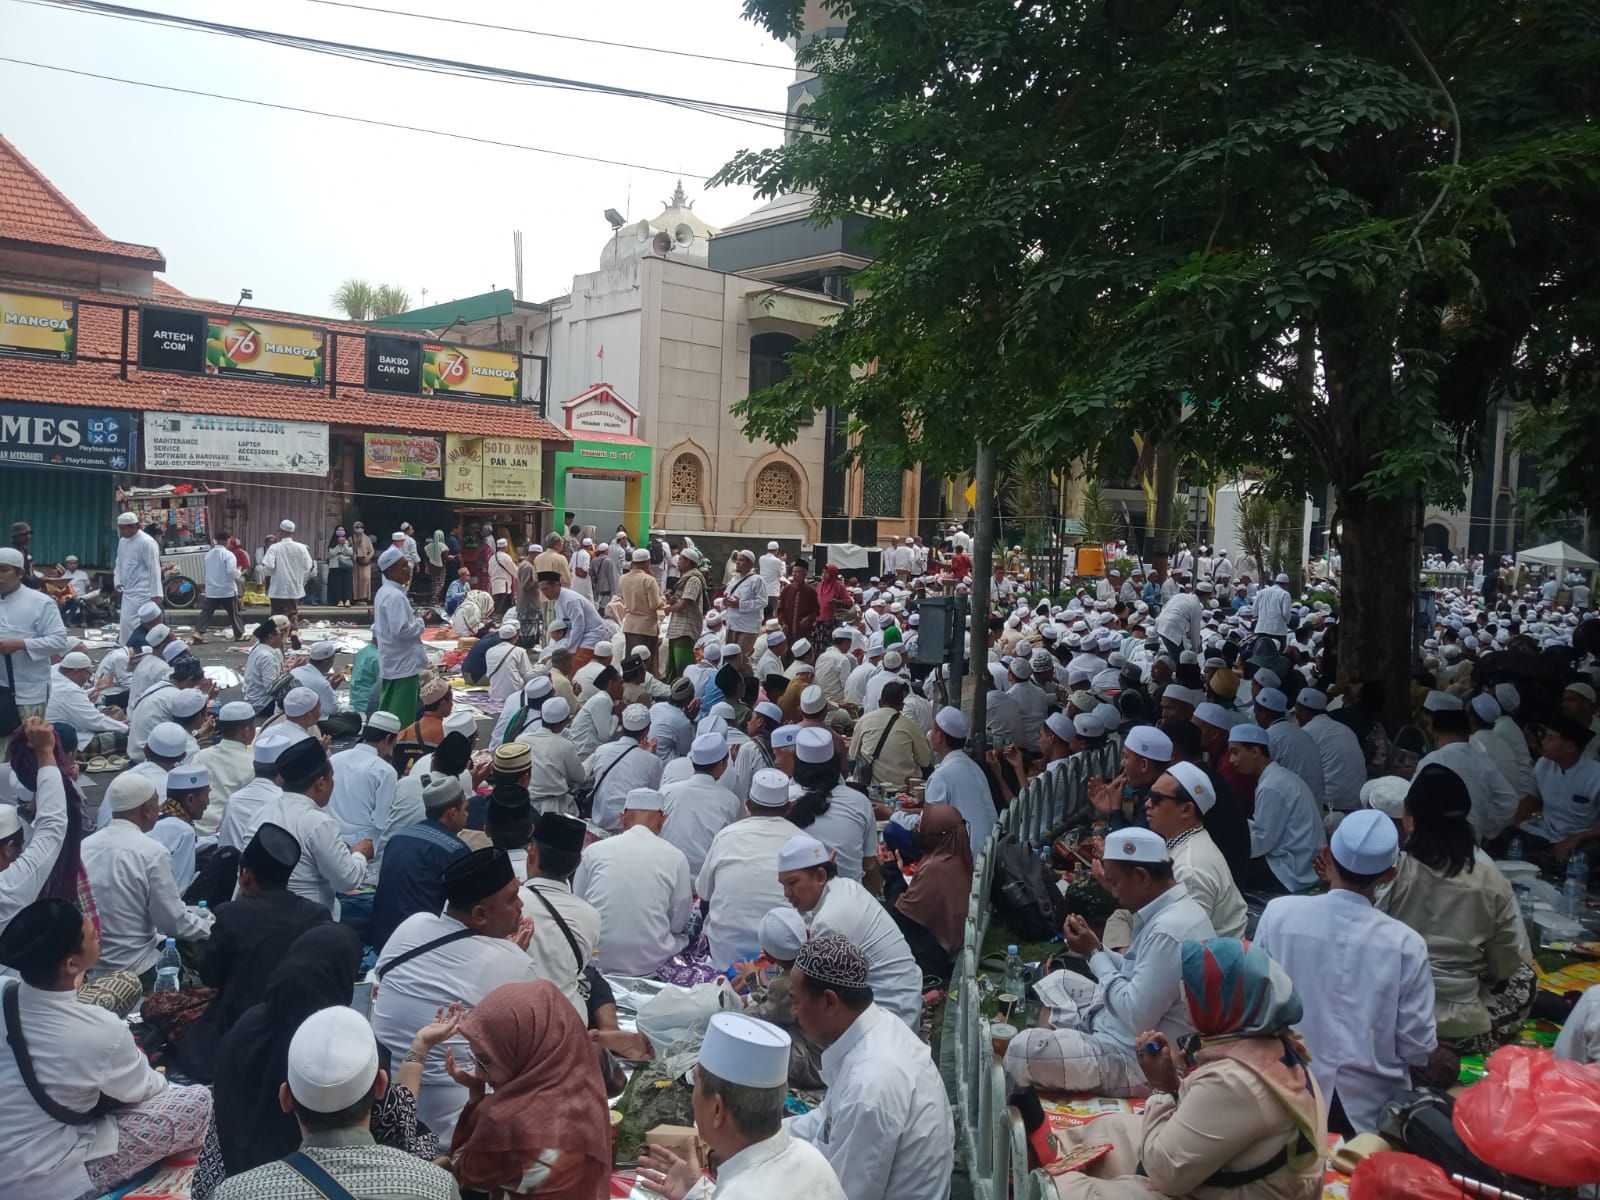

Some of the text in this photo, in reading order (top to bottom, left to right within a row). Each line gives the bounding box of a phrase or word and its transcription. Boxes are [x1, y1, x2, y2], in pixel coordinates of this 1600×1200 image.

[4, 313, 69, 330] MANGGA
[153, 330, 194, 342] ARTECH
[161, 341, 186, 351] .COM
[228, 330, 318, 358] 76 MANGGA
[379, 355, 409, 366] BAKSO
[377, 365, 410, 375] CAK NO
[440, 355, 516, 381] 76 MANGGA
[238, 448, 279, 456] ACCESSORIES
[484, 442, 539, 456] SOTO AYAM
[154, 452, 187, 460] SOFTWARE
[490, 457, 528, 467] PAK JAN
[455, 482, 474, 492] JFC
